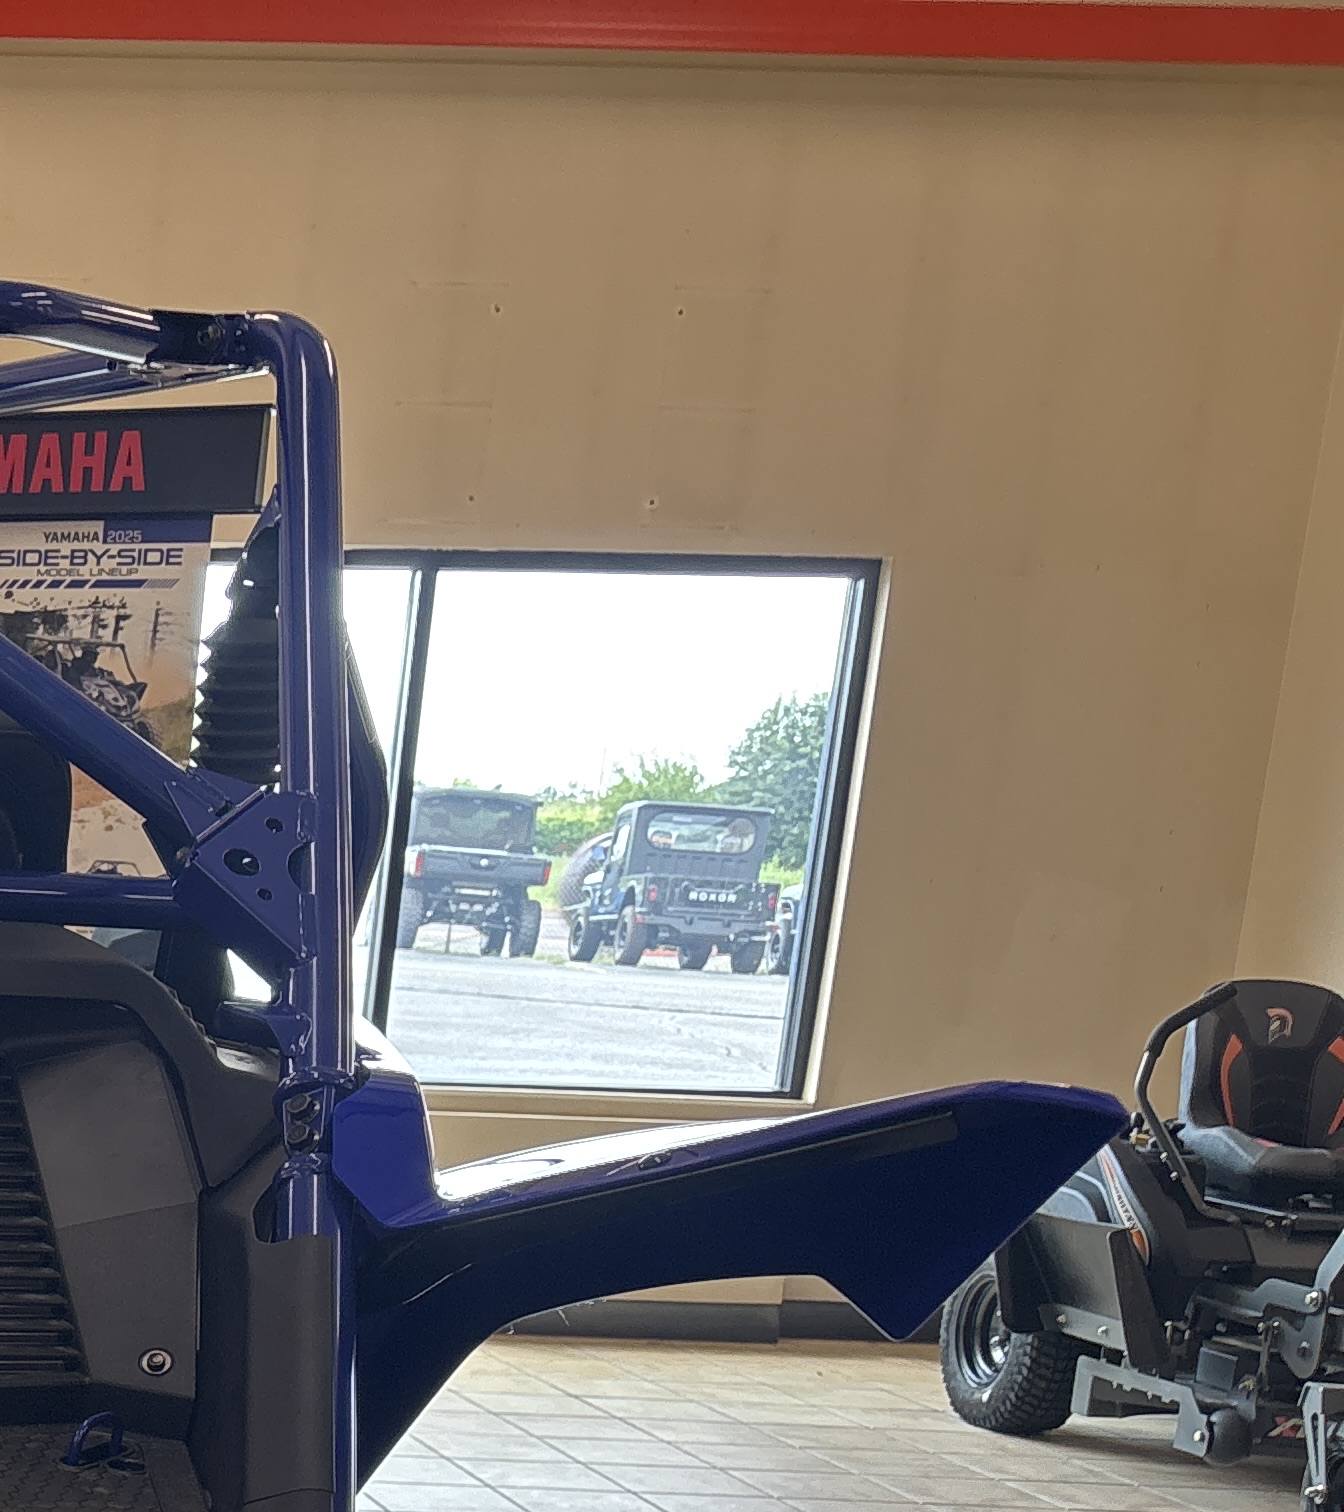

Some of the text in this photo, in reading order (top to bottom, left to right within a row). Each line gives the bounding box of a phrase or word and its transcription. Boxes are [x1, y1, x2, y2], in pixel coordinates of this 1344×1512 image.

[43, 530, 142, 544] YAMAHA 2025
[36, 568, 139, 578] MODEL LINEUP
